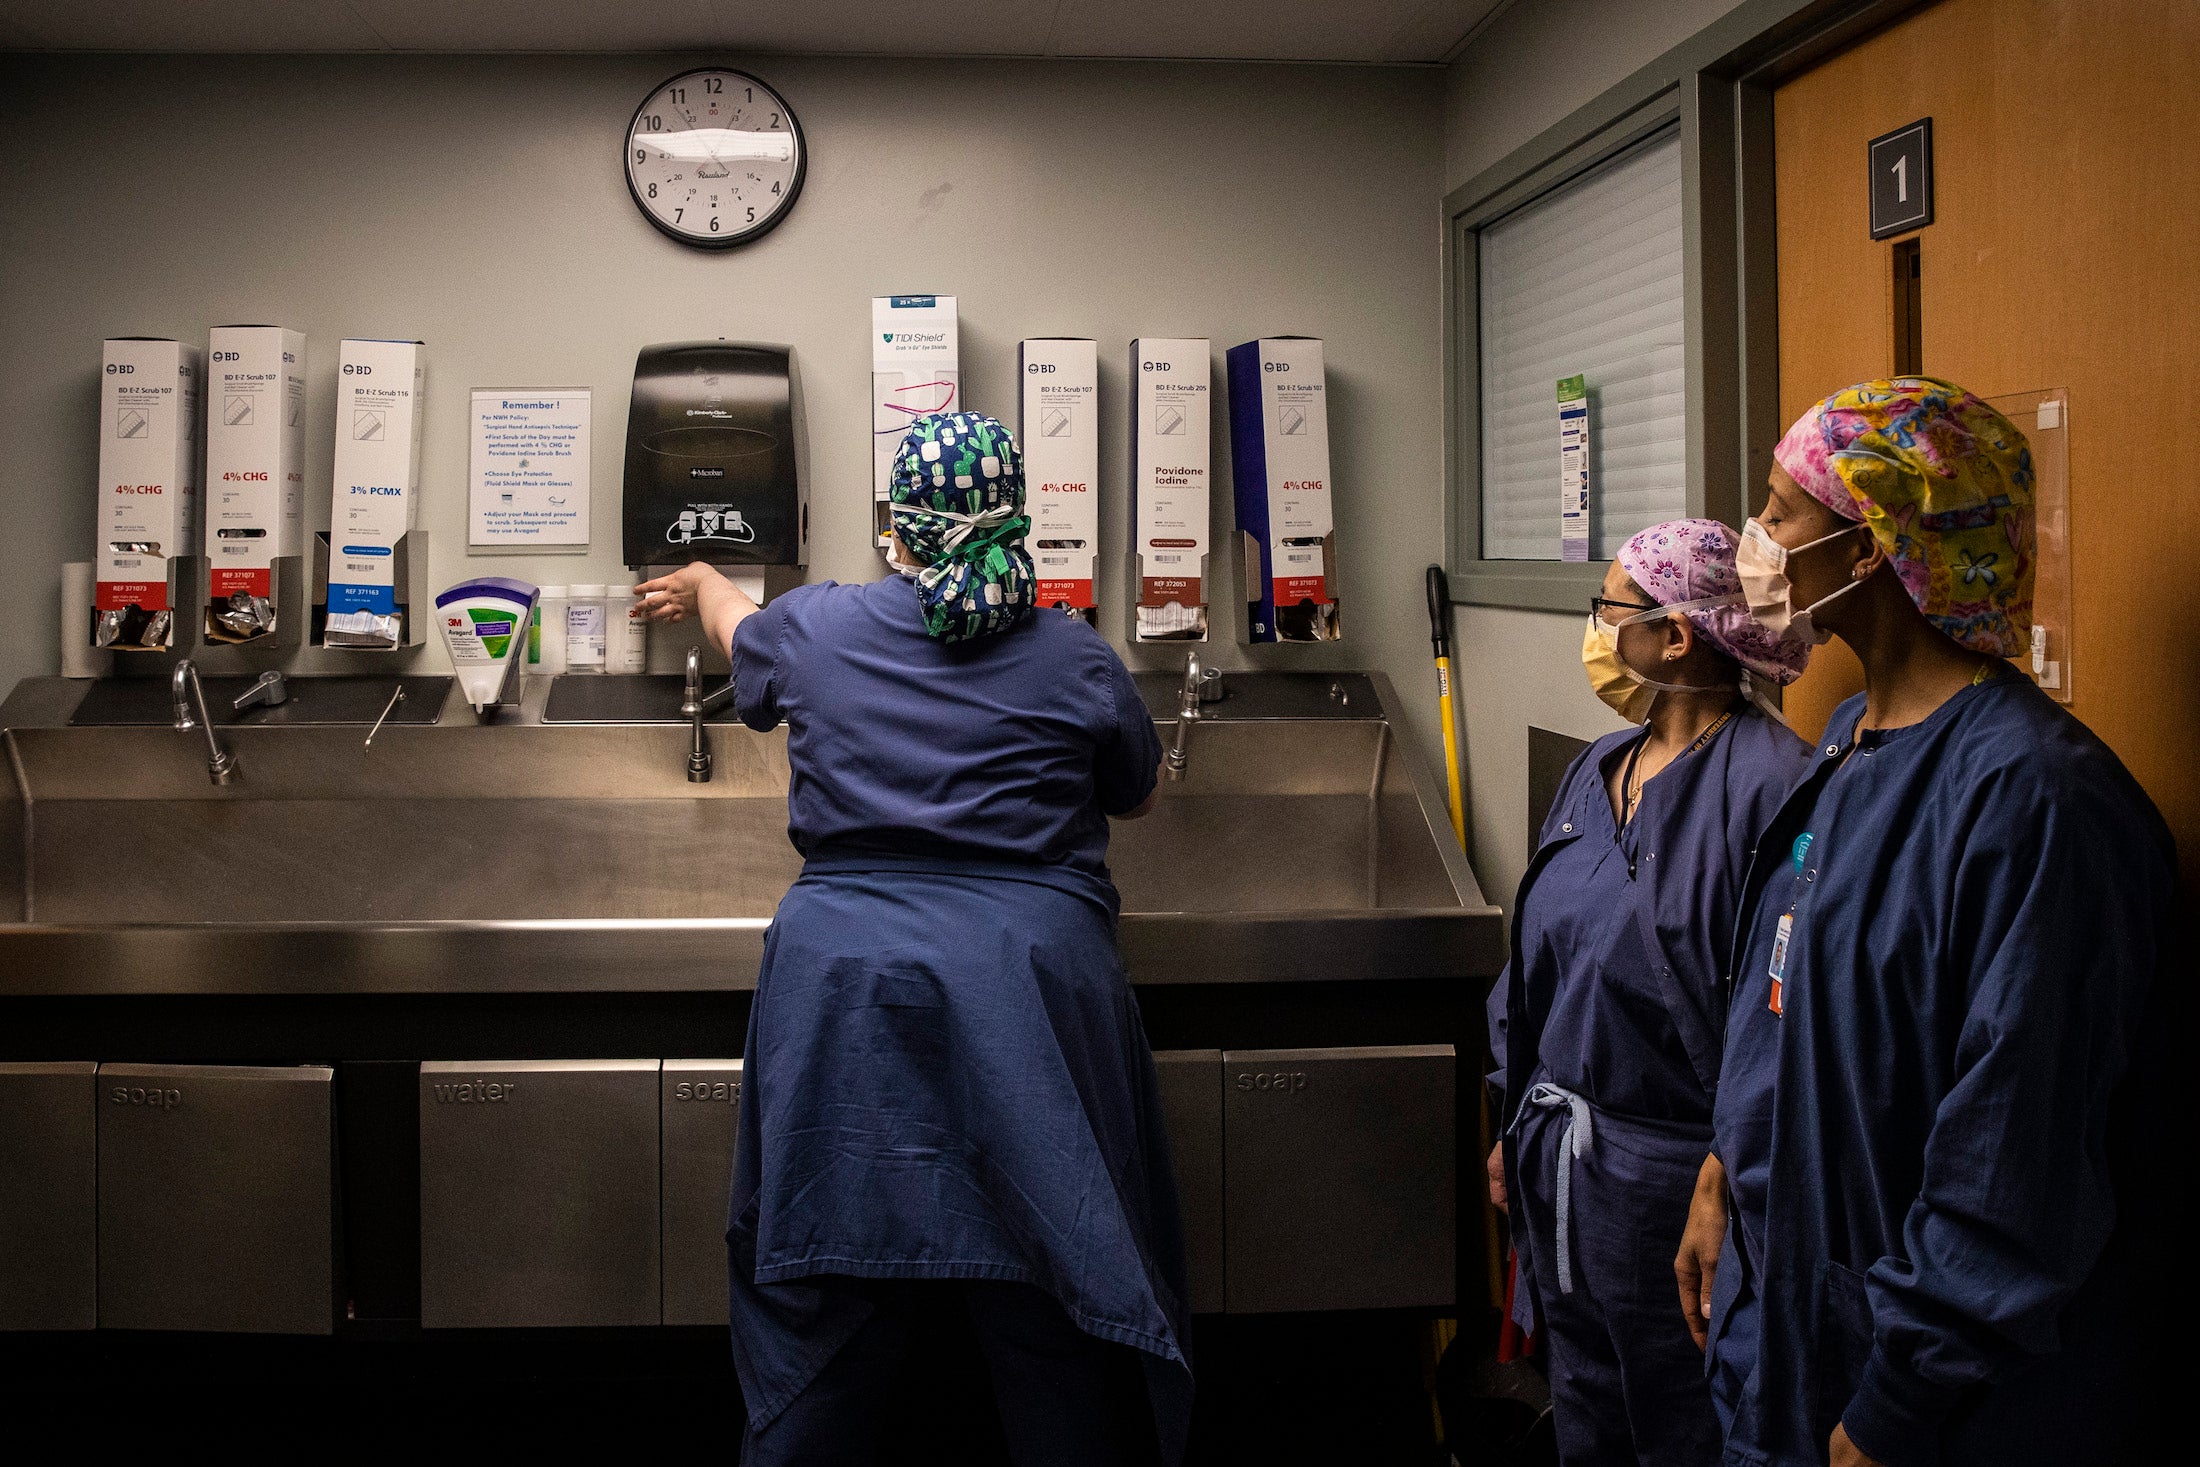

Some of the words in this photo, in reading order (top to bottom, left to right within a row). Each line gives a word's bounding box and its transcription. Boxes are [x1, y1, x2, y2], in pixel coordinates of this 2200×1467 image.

[704, 78, 722, 94] 12
[669, 88, 685, 104] 11
[745, 87, 752, 103] 1
[644, 115, 661, 131] 10
[770, 113, 780, 128] 2
[636, 149, 646, 164] 9
[780, 147, 789, 161] 3
[1891, 155, 1907, 203] 1
[648, 183, 657, 198] 8
[771, 181, 780, 196] 4
[675, 208, 684, 224] 7
[747, 207, 755, 222] 5
[710, 217, 719, 232] 6
[225, 352, 240, 361] BD
[119, 365, 134, 374] BD
[356, 365, 372, 375] BD
[1041, 364, 1056, 373] BD
[1155, 362, 1171, 371] BD
[1276, 363, 1290, 372] BD
[502, 401, 554, 409] Remember
[223, 472, 241, 481] 4%
[243, 472, 268, 481] CHG
[1155, 466, 1203, 475] Povidone
[1155, 476, 1188, 484] Iodine
[1283, 480, 1300, 490] 4%
[1301, 480, 1323, 490] CHG
[115, 485, 134, 495] 4%
[137, 485, 162, 495] CHG
[350, 486, 367, 495] 3%
[370, 487, 401, 496] PCMX
[1041, 483, 1060, 493] 4%
[1062, 483, 1087, 493] CHG
[448, 618, 462, 627] 3M
[1238, 1072, 1307, 1094] soap
[112, 1085, 182, 1108] soap
[435, 1078, 514, 1104] water
[676, 1082, 741, 1105] soap
